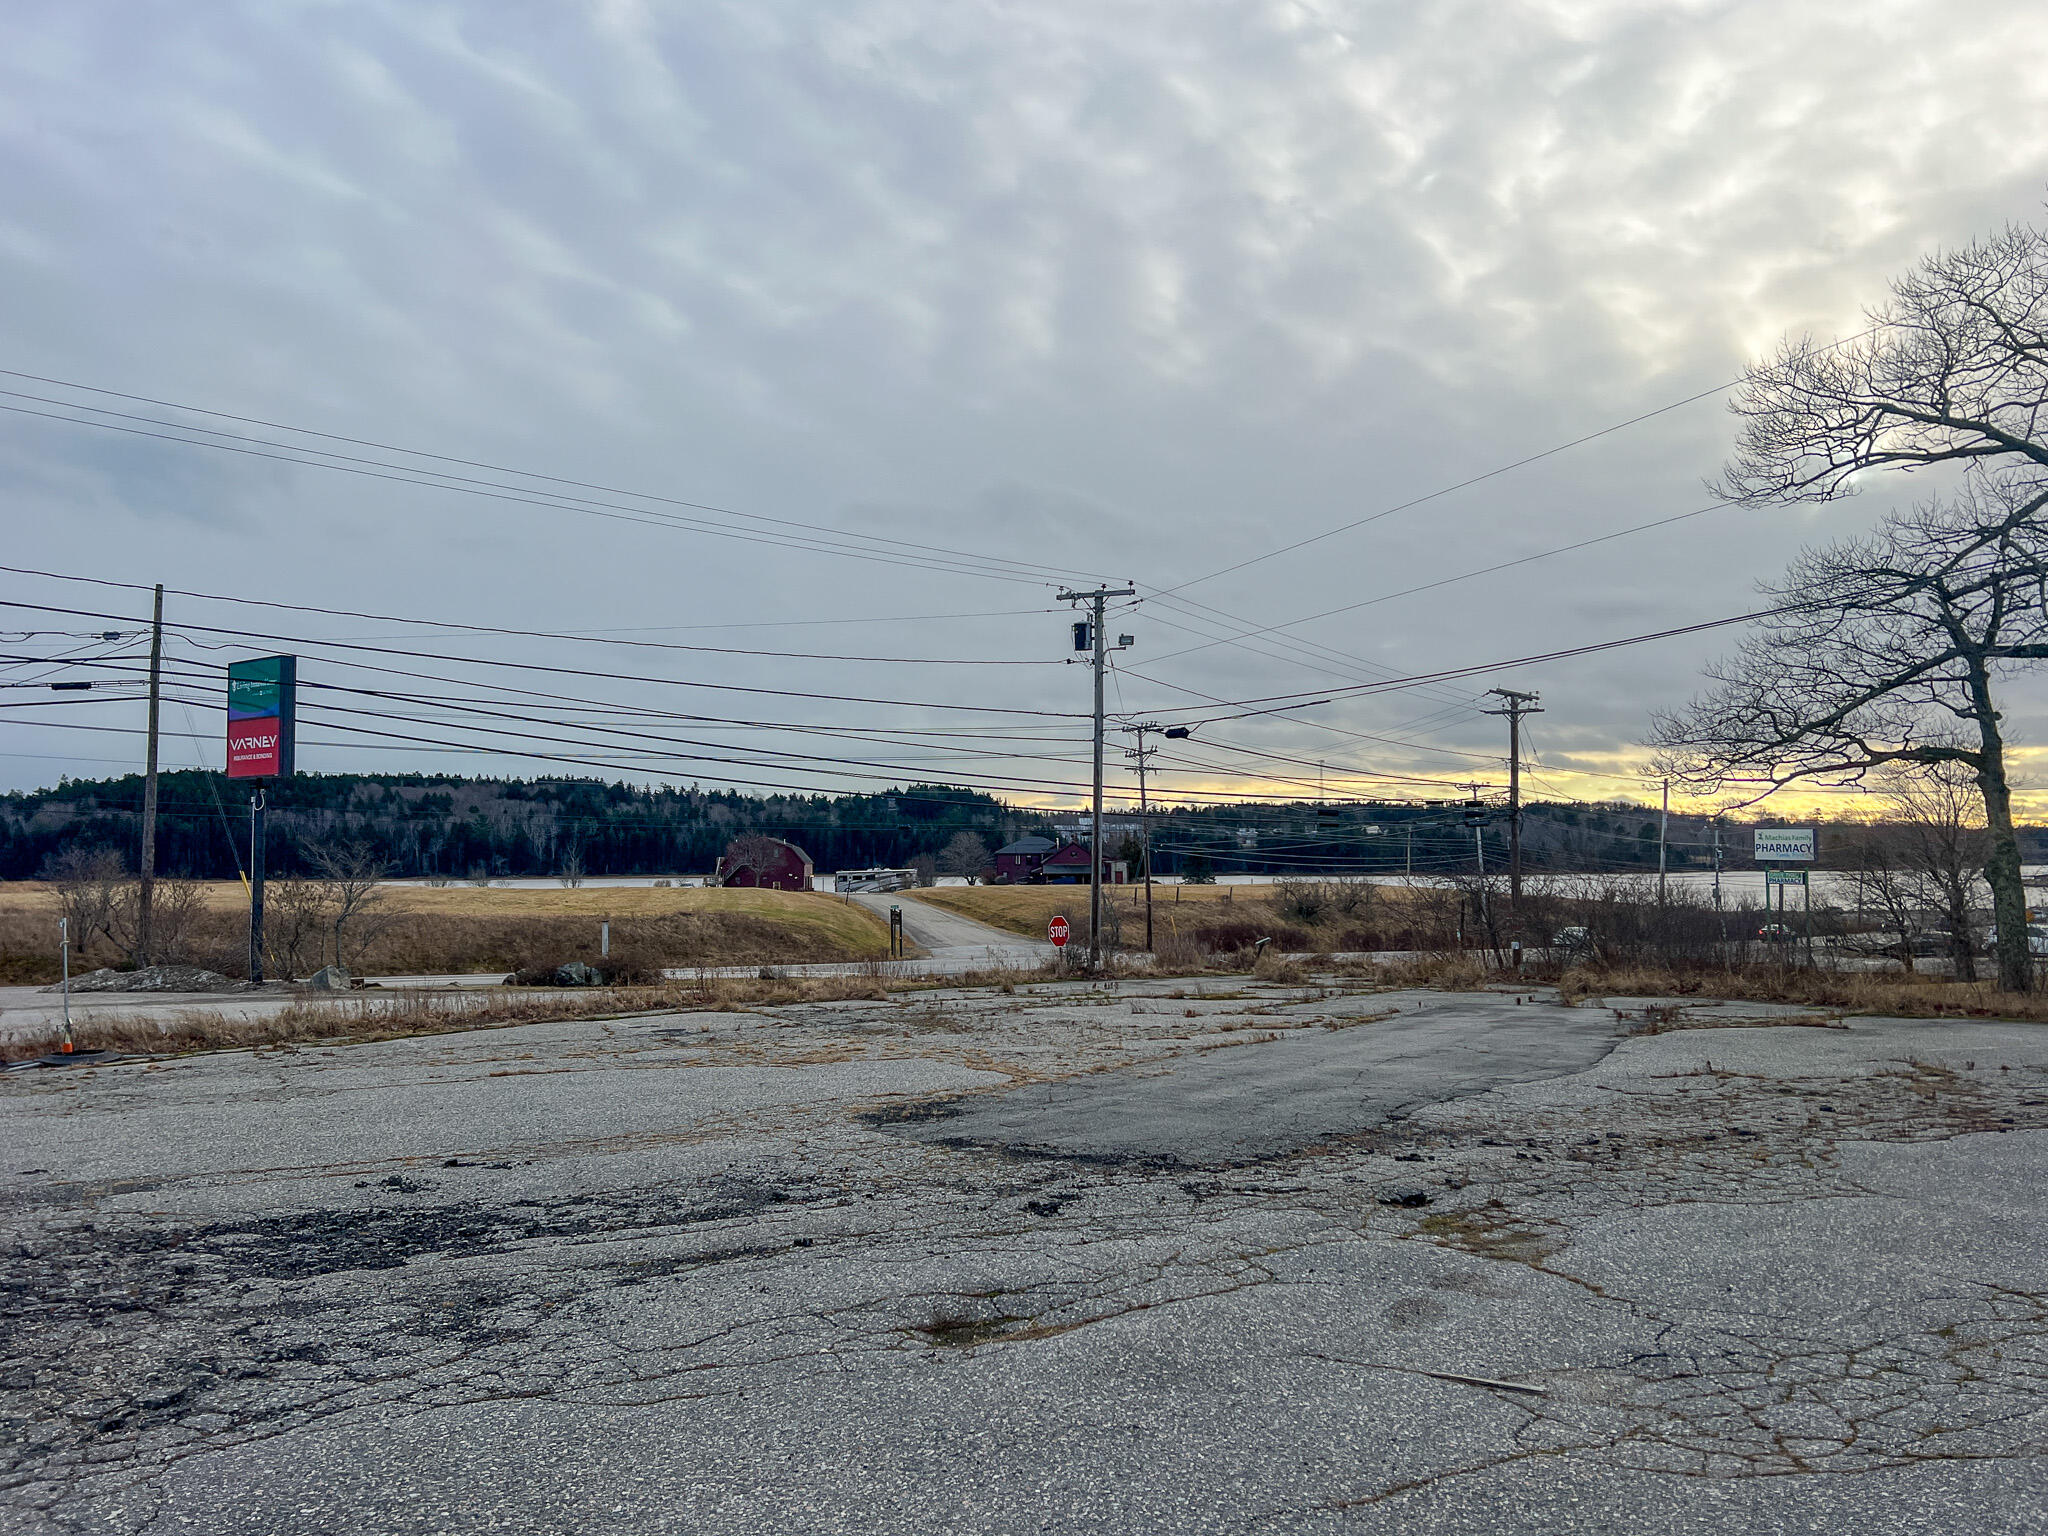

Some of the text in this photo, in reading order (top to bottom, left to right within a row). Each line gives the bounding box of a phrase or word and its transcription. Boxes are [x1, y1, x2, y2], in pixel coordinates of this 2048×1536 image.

[230, 735, 277, 750] VARNEY
[1791, 834, 1812, 842] Family
[1755, 843, 1812, 853] PHARMACY
[1050, 925, 1068, 938] STOP
